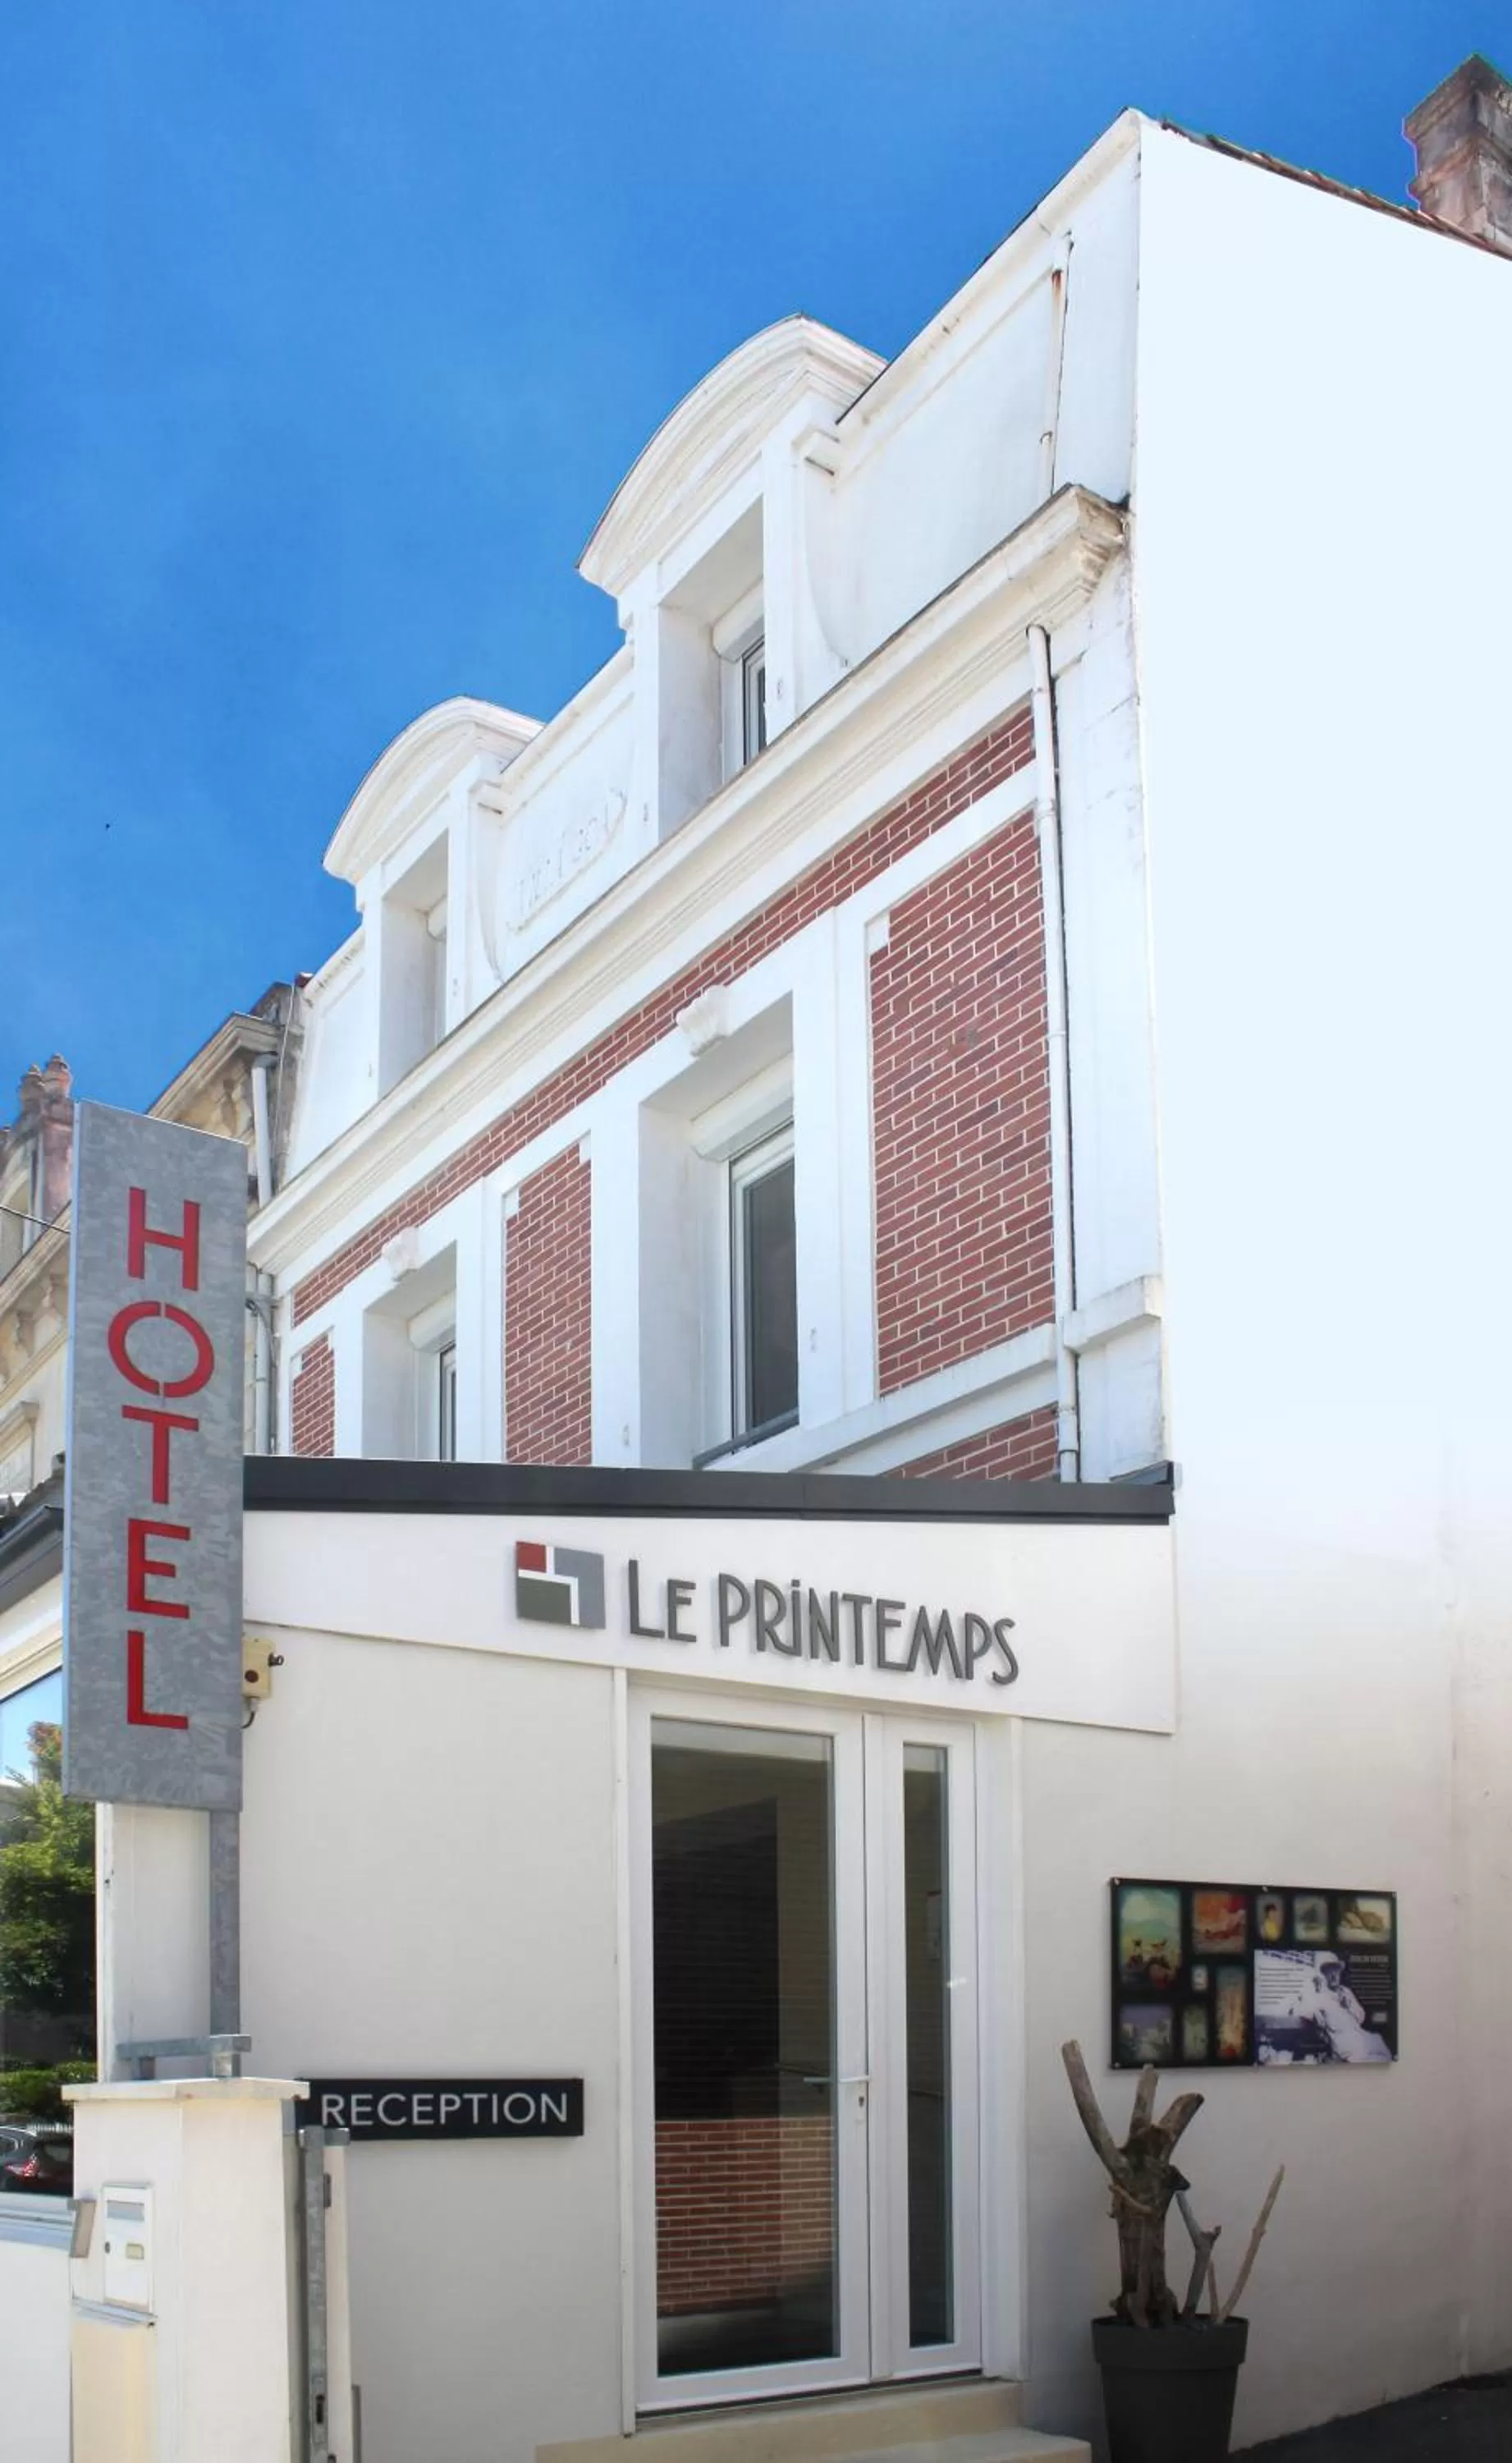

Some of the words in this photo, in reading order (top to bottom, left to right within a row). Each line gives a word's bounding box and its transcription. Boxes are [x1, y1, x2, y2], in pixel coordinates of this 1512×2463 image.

[107, 1186, 215, 1730] HOTEL
[628, 1559, 697, 1643] LE
[321, 2092, 567, 2126] RECEPTION
